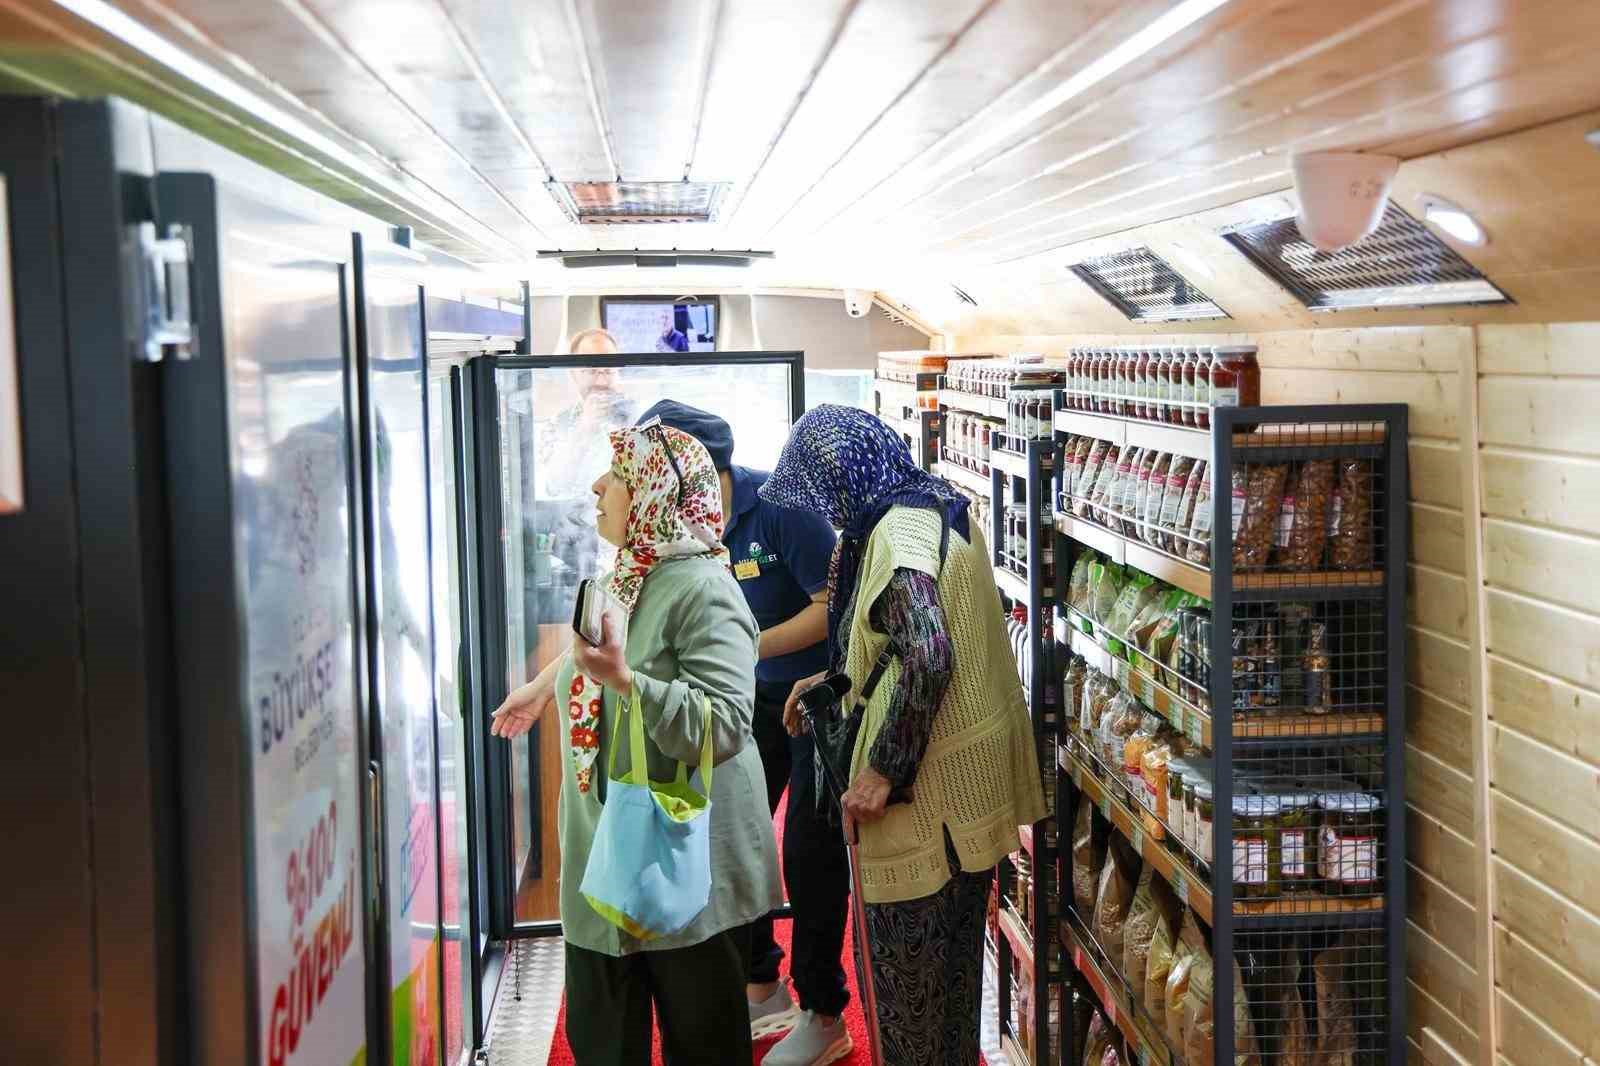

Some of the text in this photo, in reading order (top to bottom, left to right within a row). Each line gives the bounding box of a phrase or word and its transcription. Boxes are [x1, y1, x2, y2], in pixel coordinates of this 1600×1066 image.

[260, 641, 331, 755] BÜYÜKŞE
[286, 800, 337, 942] %100
[268, 848, 355, 1066] GÜVENLİ
